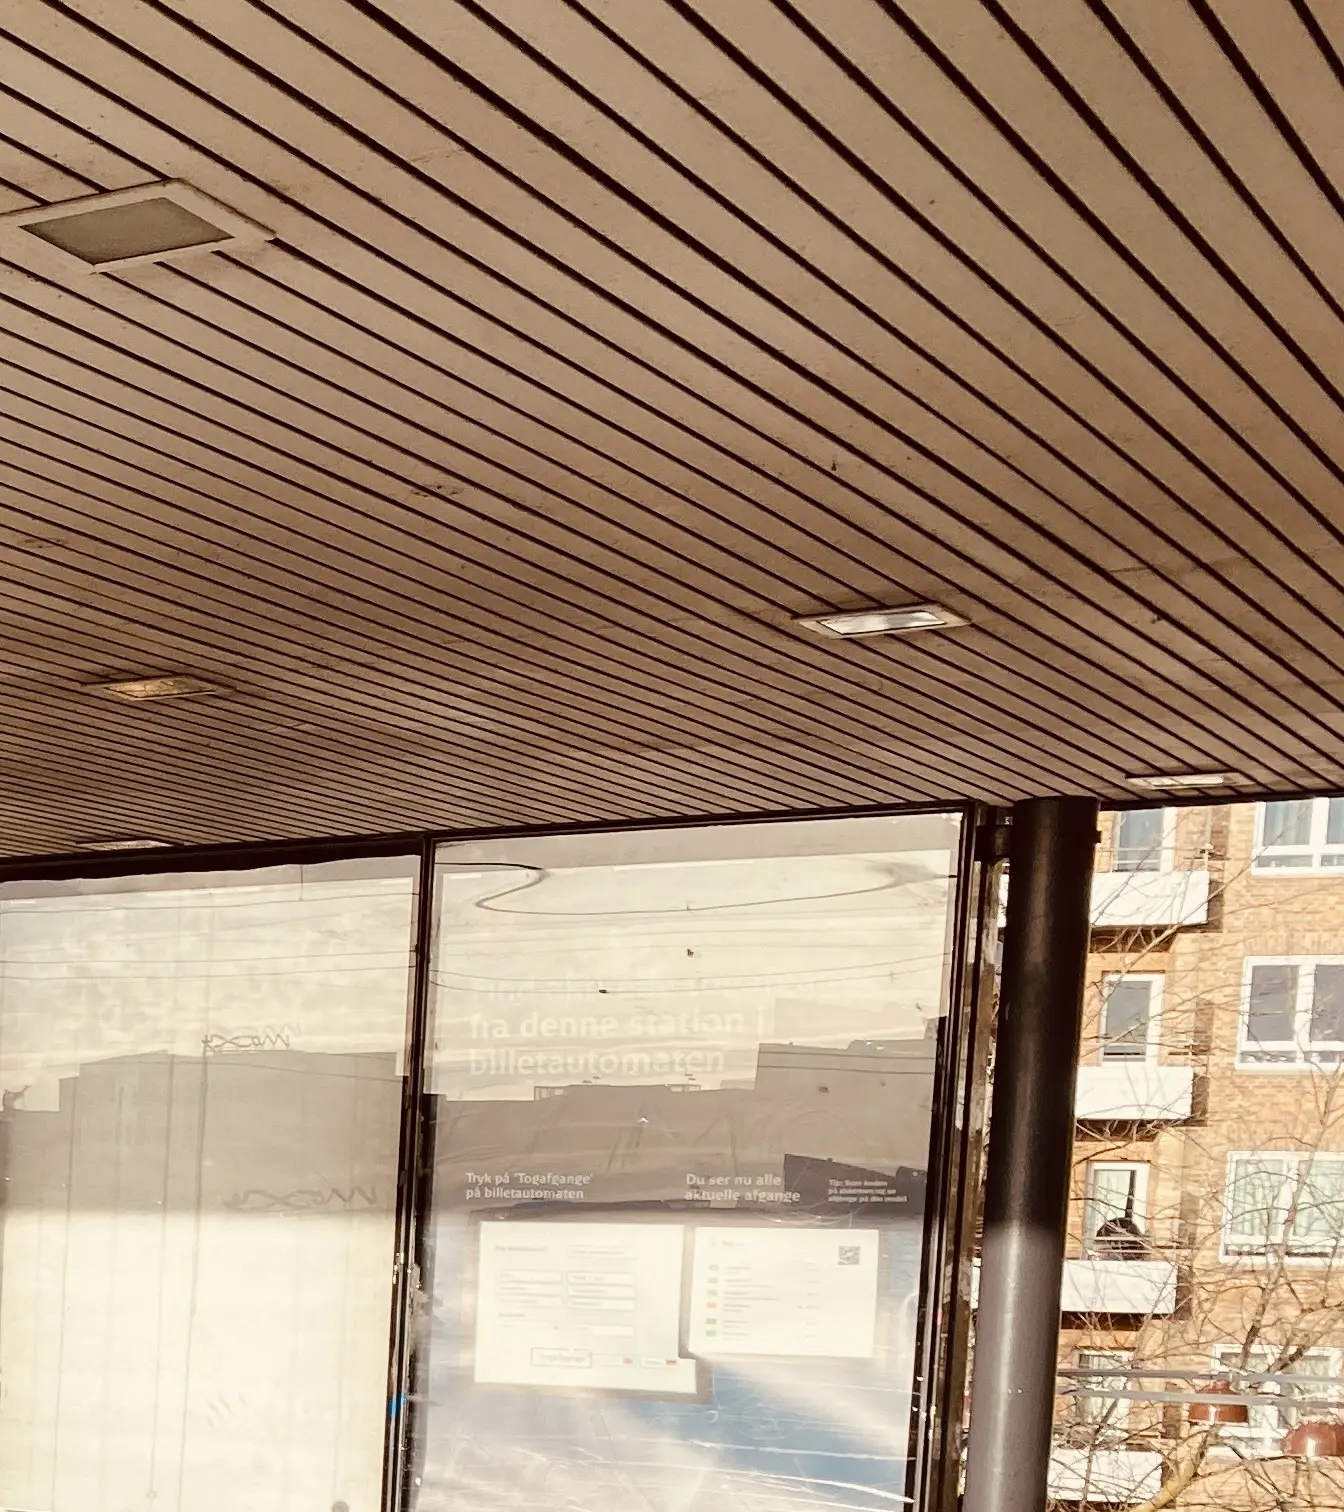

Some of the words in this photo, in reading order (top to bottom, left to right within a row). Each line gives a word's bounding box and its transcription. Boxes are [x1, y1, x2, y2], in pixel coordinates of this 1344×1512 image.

[469, 1010, 510, 1040] fra
[519, 1010, 619, 1039] denne
[628, 1007, 745, 1037] station
[468, 1047, 725, 1077] billetautomaten
[465, 1172, 492, 1186] Tryk
[495, 1172, 511, 1186] på
[686, 1173, 706, 1185] Du
[708, 1175, 732, 1186] ser
[734, 1176, 752, 1186] nu
[756, 1173, 782, 1186] alle
[466, 1186, 481, 1200] på
[484, 1187, 584, 1199] billetautomaten
[684, 1189, 740, 1201] aktuelle
[744, 1189, 801, 1203] afgange
